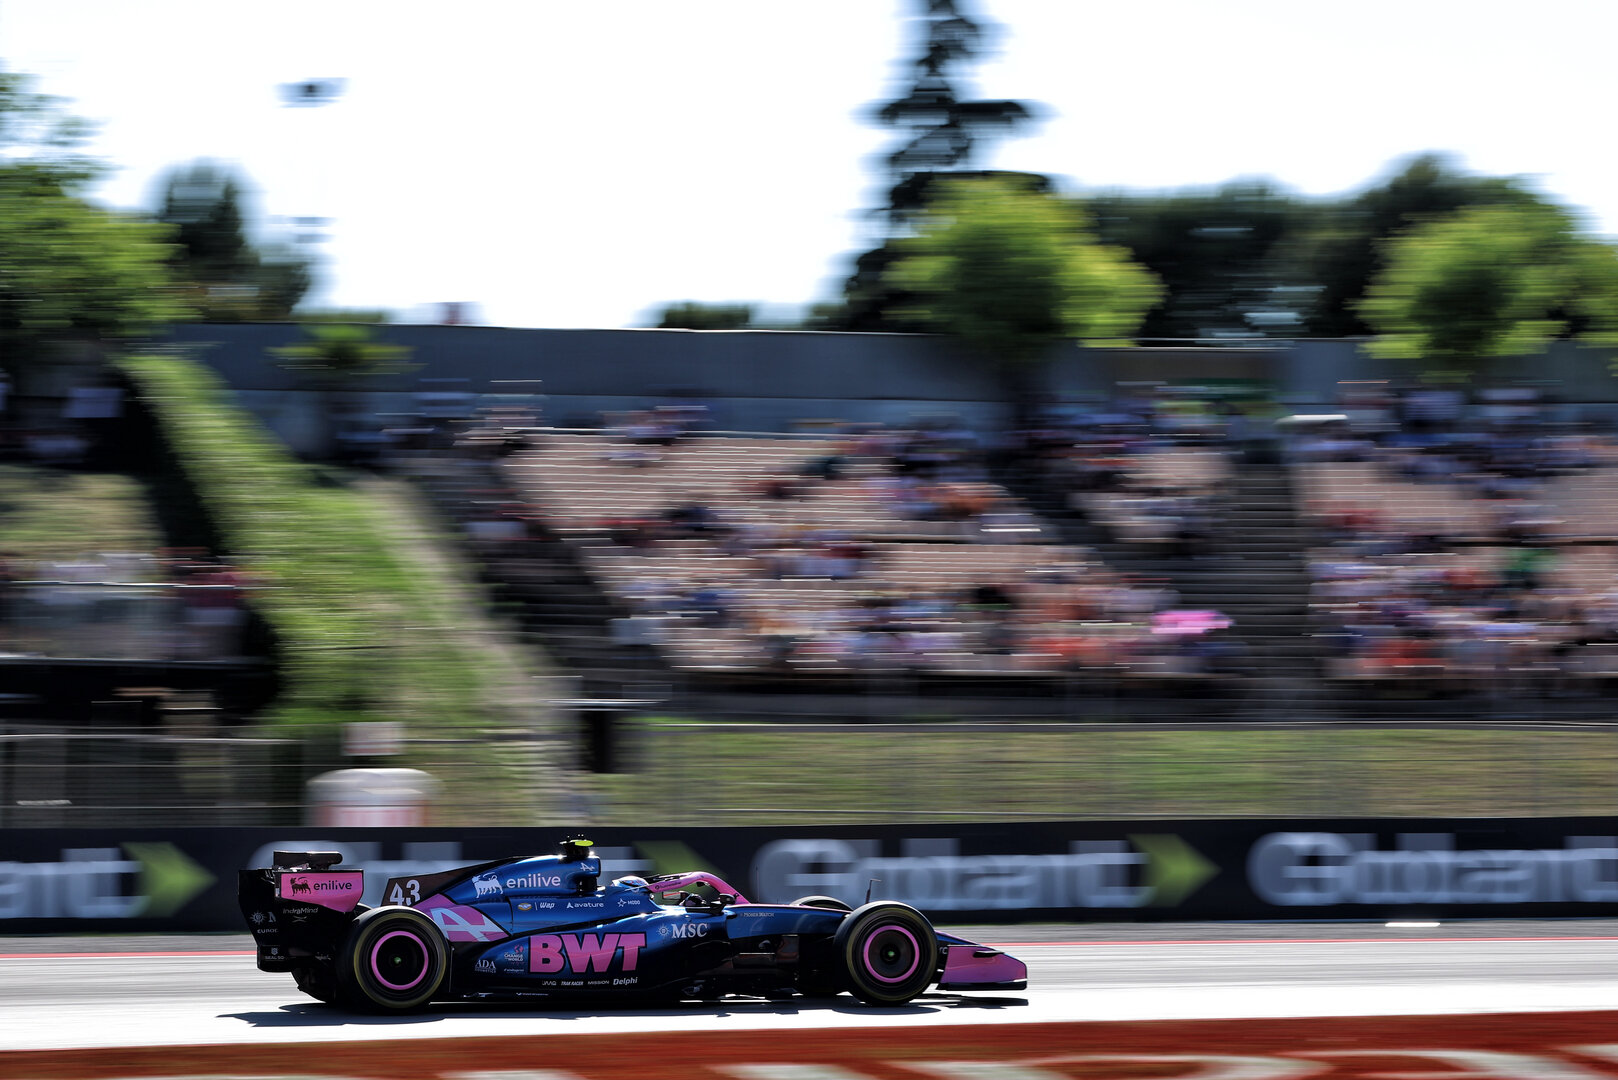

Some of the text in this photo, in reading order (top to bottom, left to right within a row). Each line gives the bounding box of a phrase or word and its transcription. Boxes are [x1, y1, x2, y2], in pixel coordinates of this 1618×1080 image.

[313, 880, 352, 890] enilive
[506, 873, 561, 889] enilive
[389, 879, 420, 906] 43
[283, 907, 318, 915] IndraMind
[671, 922, 708, 939] MSC
[529, 933, 646, 974] BWT
[475, 959, 496, 969] ADA
[613, 977, 638, 985] Delphi
